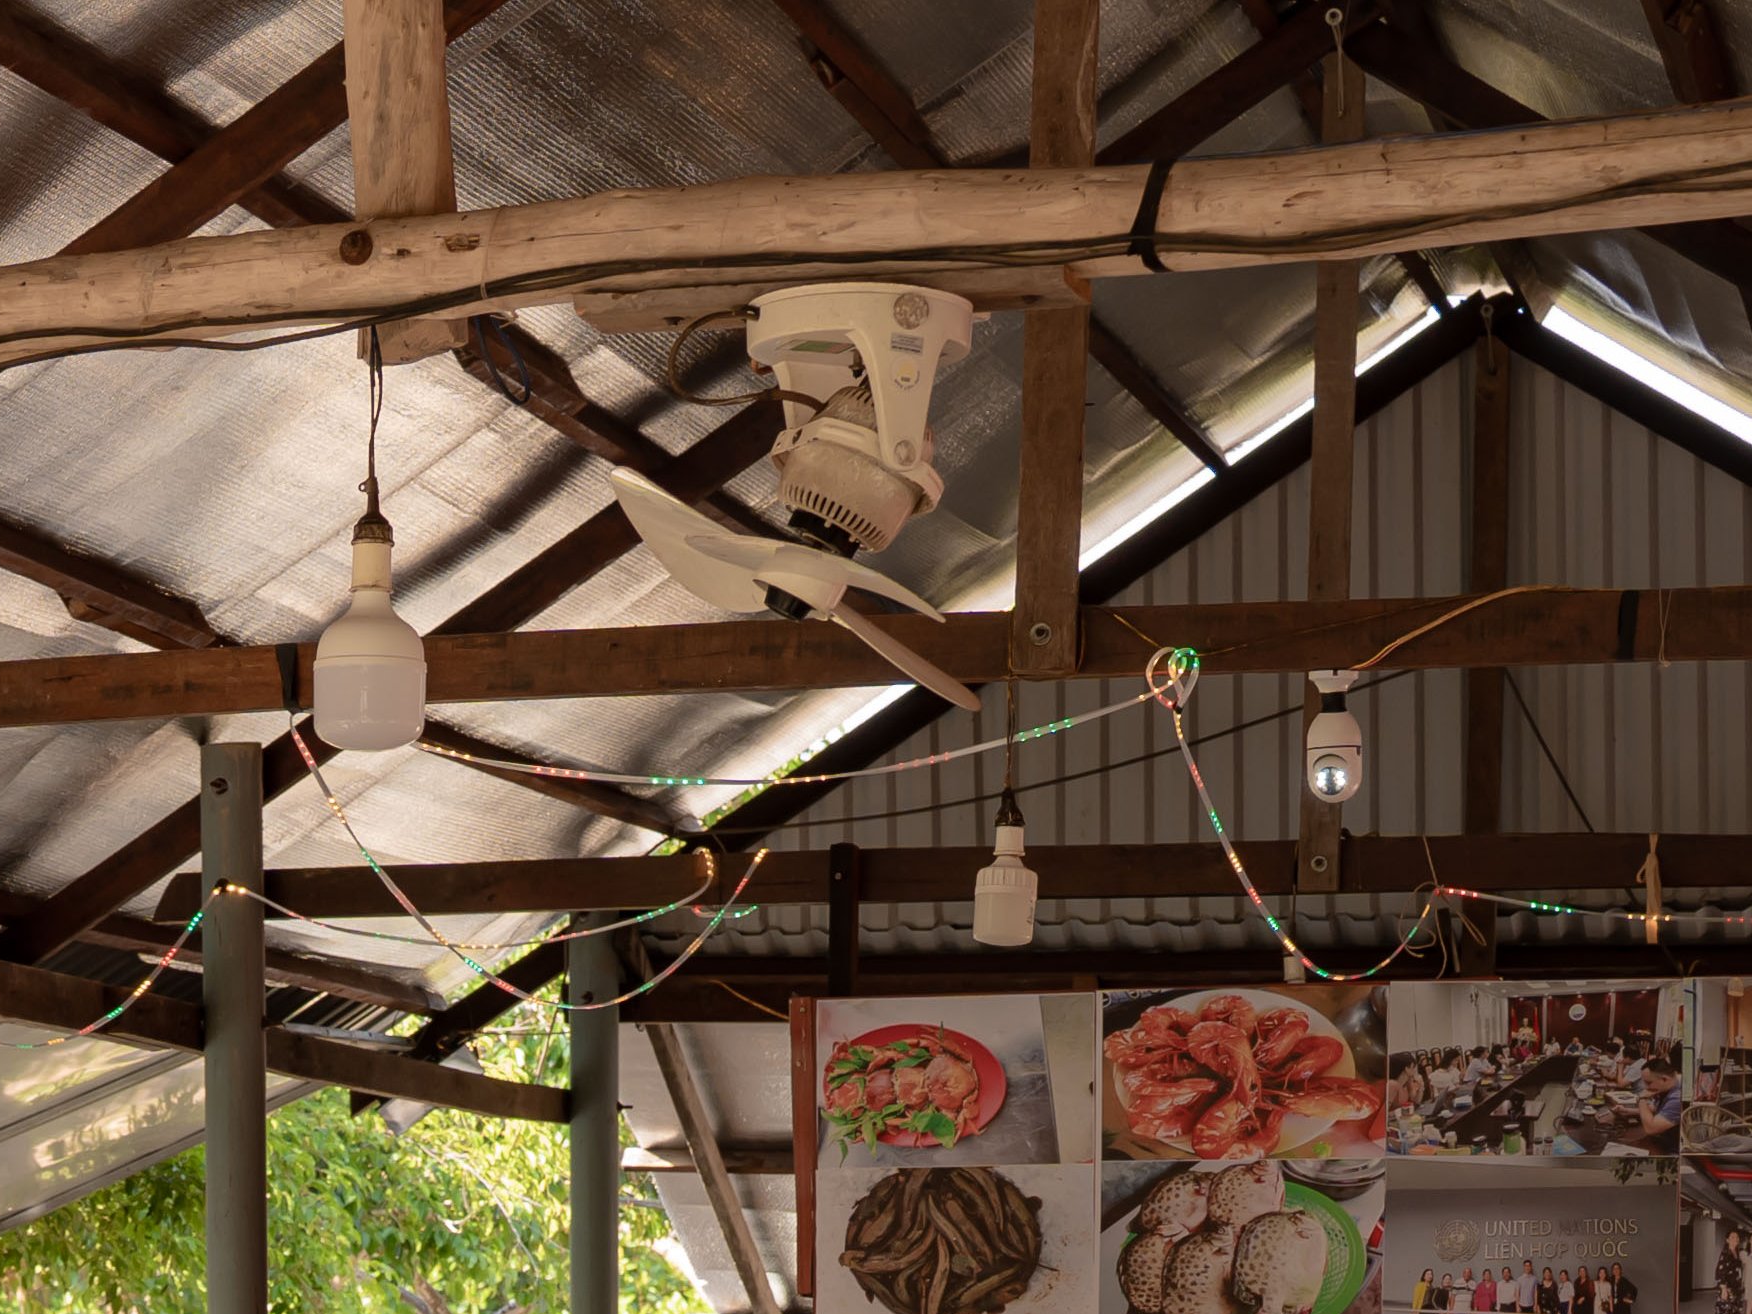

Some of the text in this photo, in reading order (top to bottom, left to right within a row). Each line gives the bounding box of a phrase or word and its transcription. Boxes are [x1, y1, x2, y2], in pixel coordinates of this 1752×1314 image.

[1485, 1217, 1640, 1238] UNITED NATIONS
[1484, 1240, 1524, 1260] LIÊN
